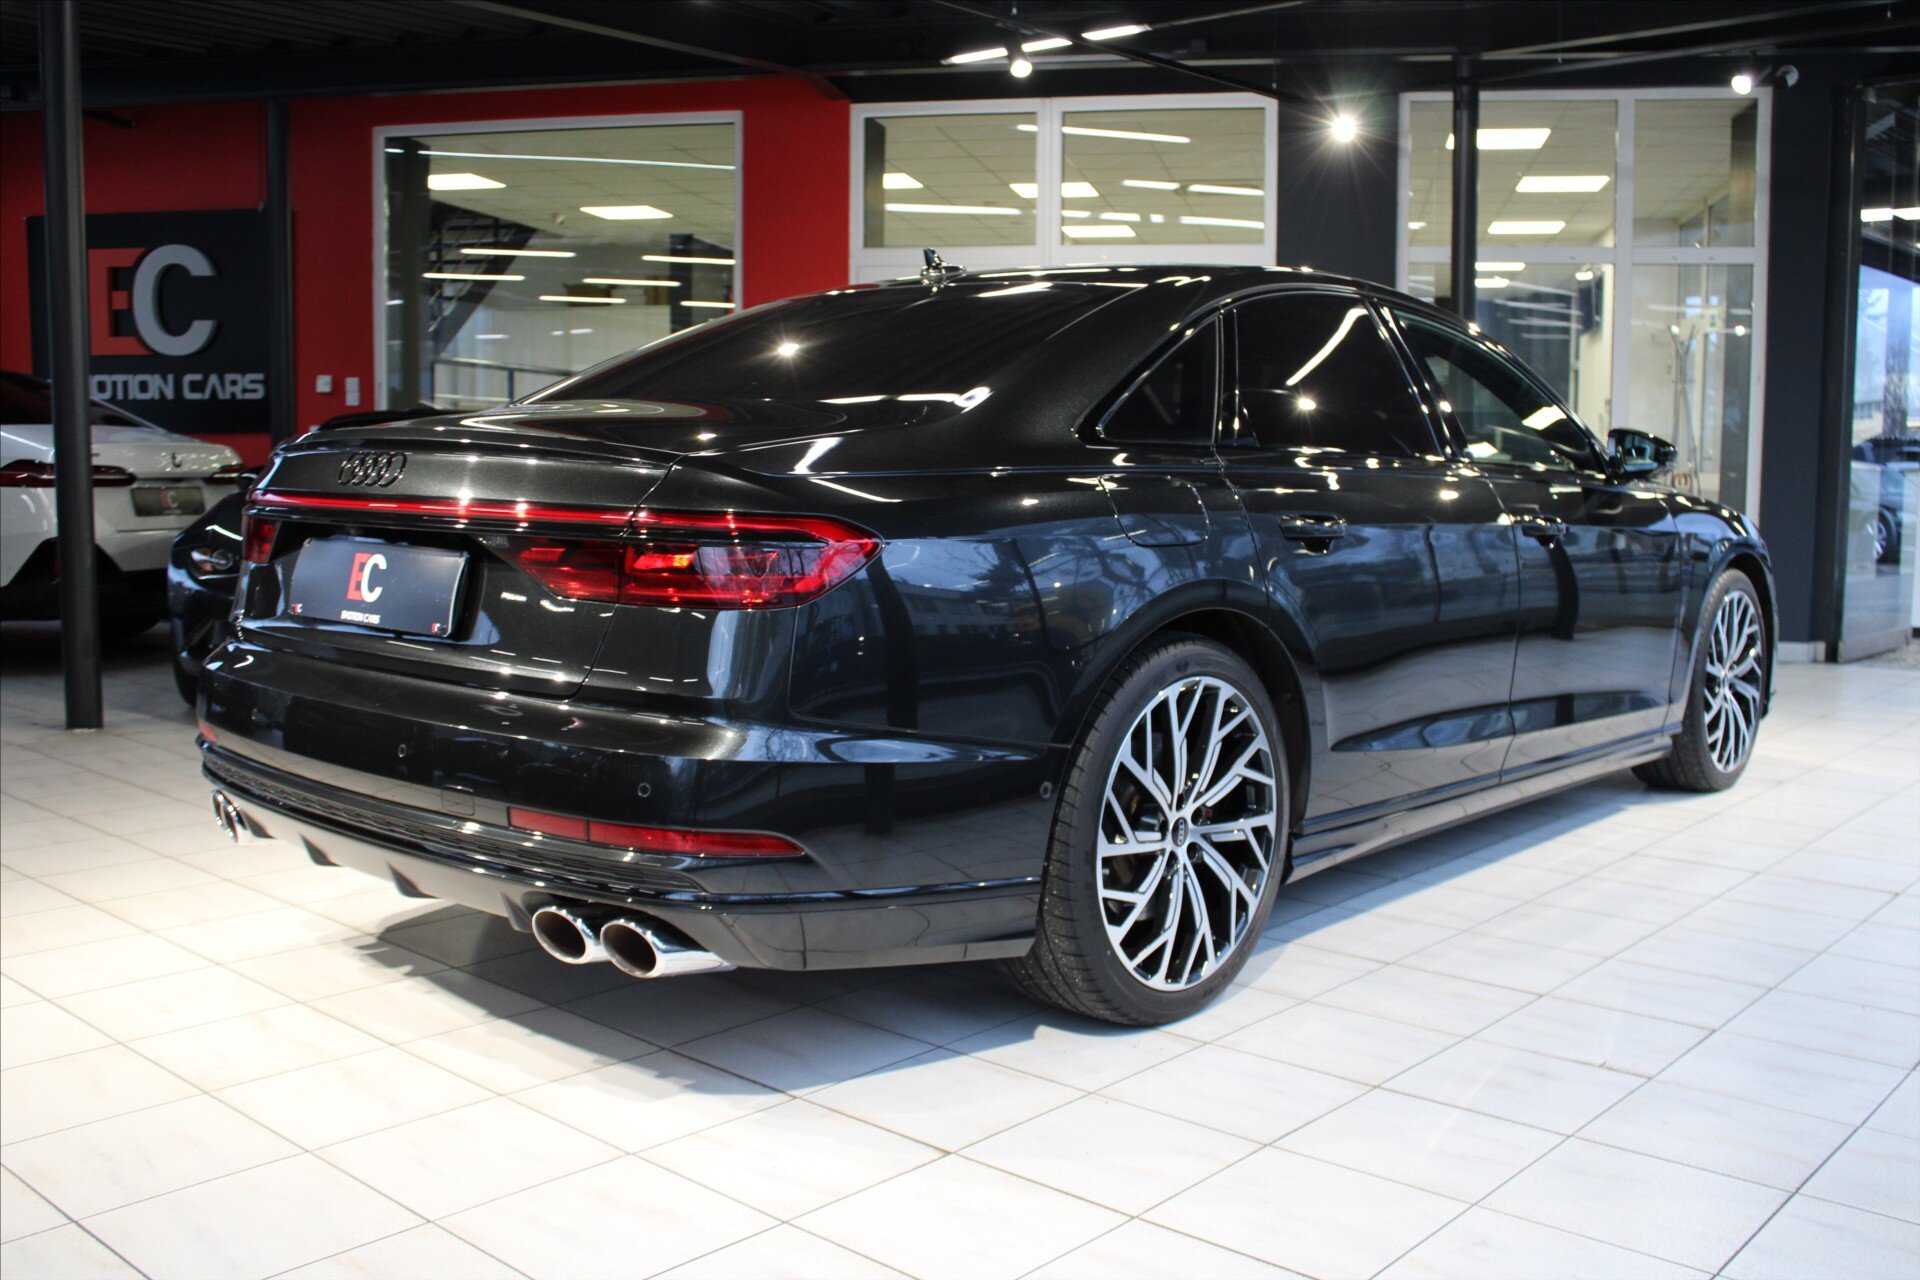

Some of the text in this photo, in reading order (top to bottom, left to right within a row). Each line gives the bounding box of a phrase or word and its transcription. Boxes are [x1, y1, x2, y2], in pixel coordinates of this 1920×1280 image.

[88, 244, 217, 356] EC
[89, 373, 265, 400] OTION CARS
[346, 552, 387, 602] EC
